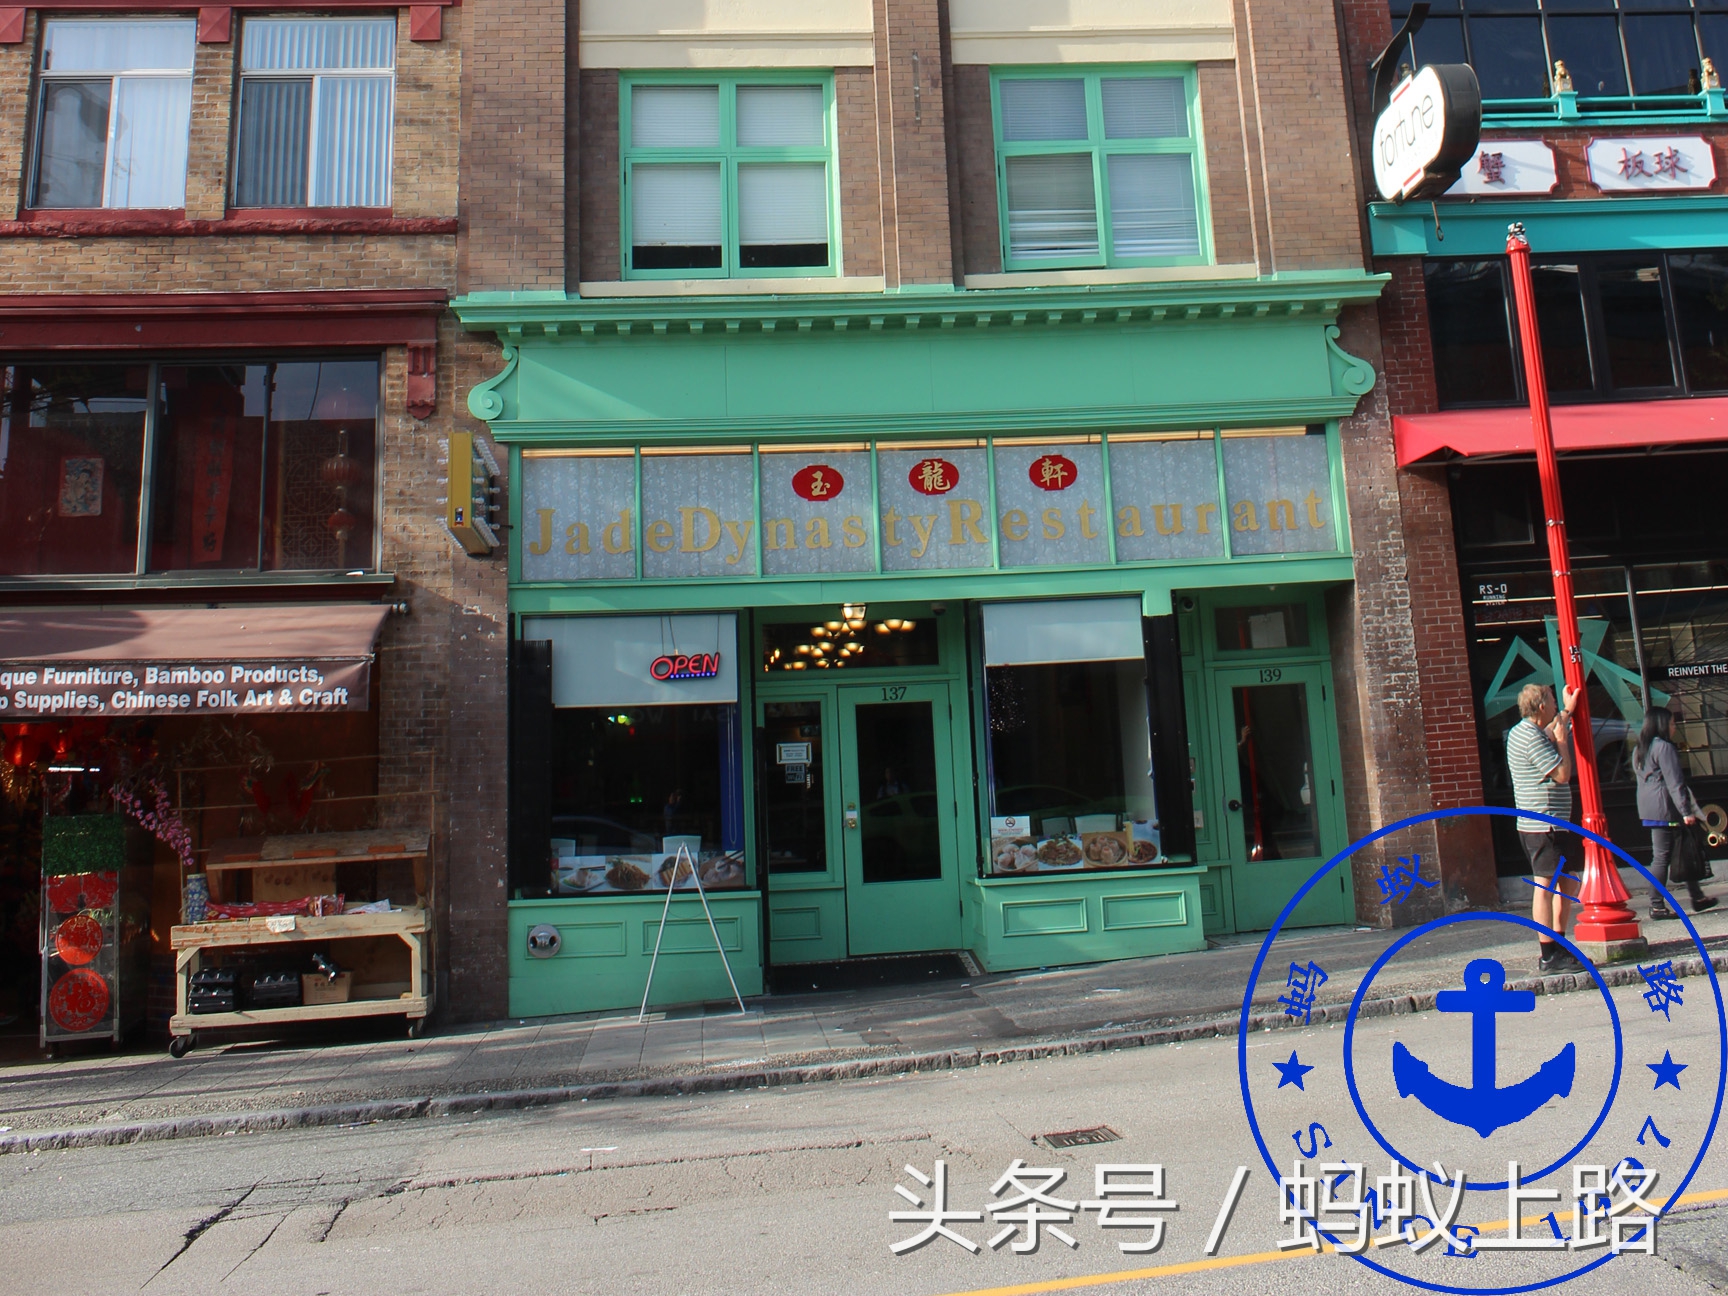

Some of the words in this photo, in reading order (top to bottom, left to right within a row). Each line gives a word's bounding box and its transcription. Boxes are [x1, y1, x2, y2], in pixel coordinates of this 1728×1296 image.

[1380, 94, 1435, 172] fortune
[811, 471, 831, 497] 玉
[918, 461, 950, 492] 龍
[0, 671, 38, 690] que
[43, 666, 140, 689] Furniture,
[145, 666, 225, 685] Bamboo
[230, 664, 324, 686] Products,
[650, 651, 721, 681] OPEN
[1259, 667, 1282, 683] 139
[1668, 665, 1709, 677] REINVENT
[1711, 664, 1728, 674] THE
[14, 689, 105, 713] Supplies,
[111, 689, 191, 709] Chinese
[196, 689, 238, 708] Folk
[243, 688, 274, 707] Art
[278, 689, 294, 706] &
[299, 687, 348, 706] Craft
[881, 685, 907, 702] 137
